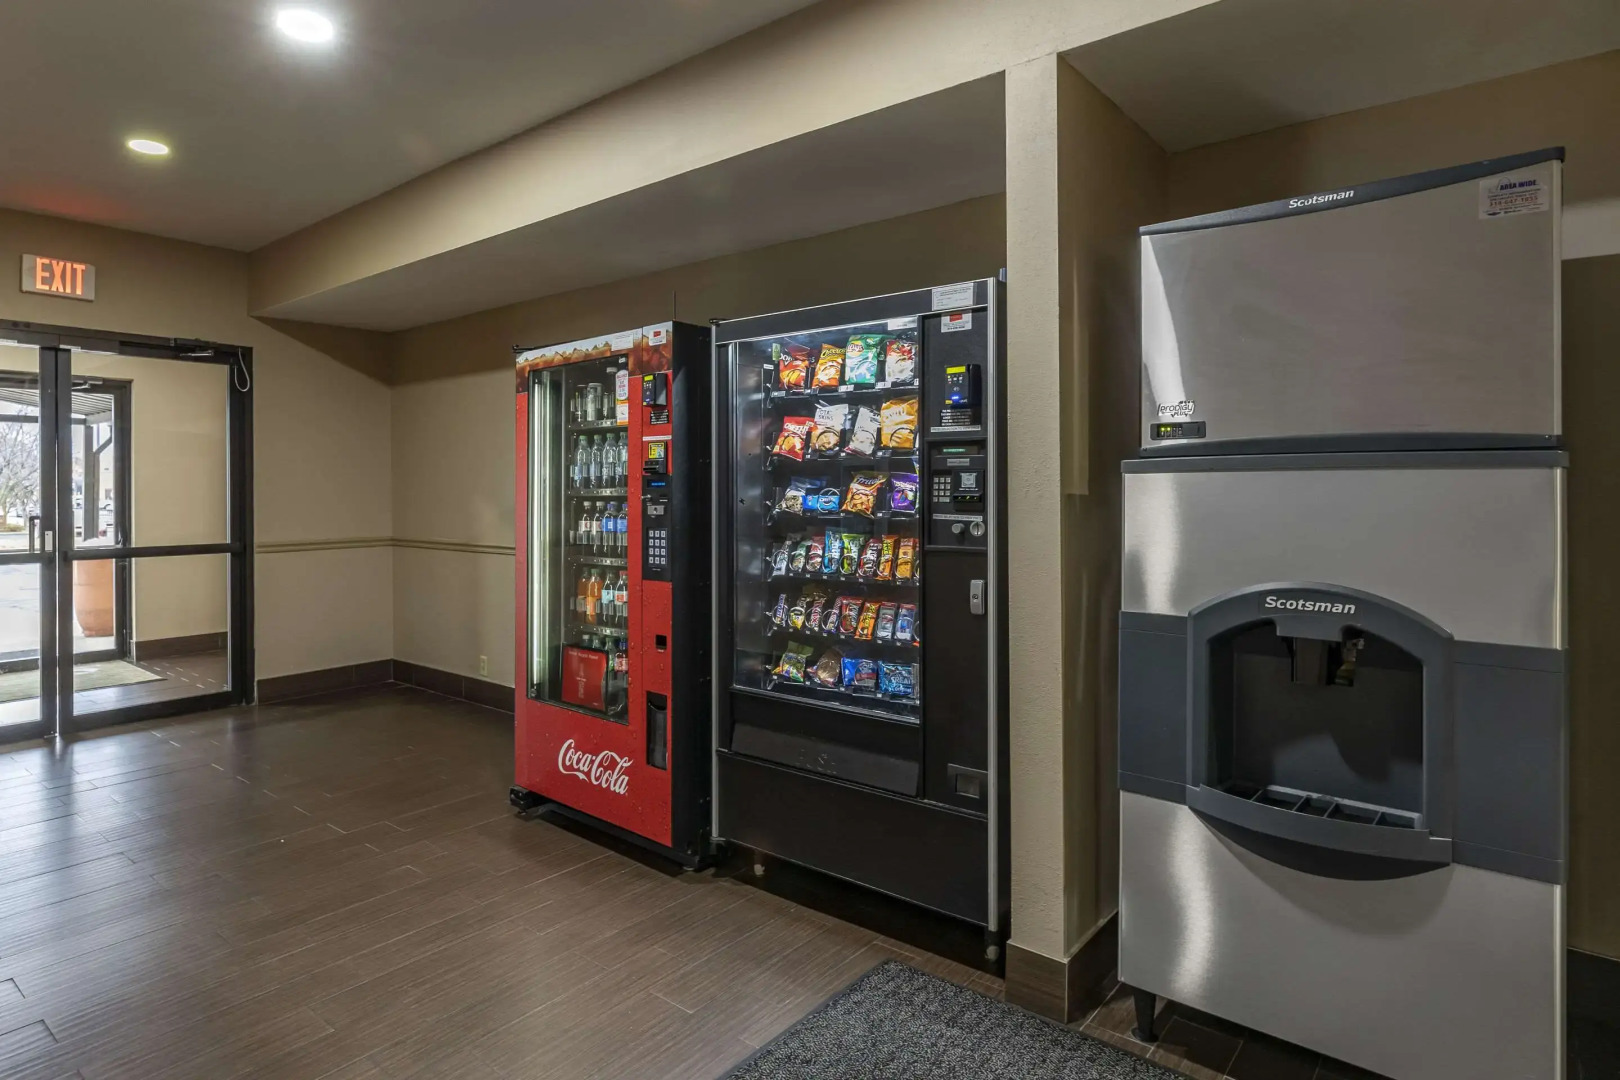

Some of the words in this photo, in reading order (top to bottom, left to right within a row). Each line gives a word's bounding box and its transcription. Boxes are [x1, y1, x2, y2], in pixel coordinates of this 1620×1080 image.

[1500, 181, 1517, 191] AREA
[1518, 179, 1537, 188] WIDE
[1288, 189, 1355, 209] Scotsman
[35, 256, 87, 296] EXIT
[1264, 595, 1357, 614] Scotsman
[557, 738, 634, 795] Coca-Cola
